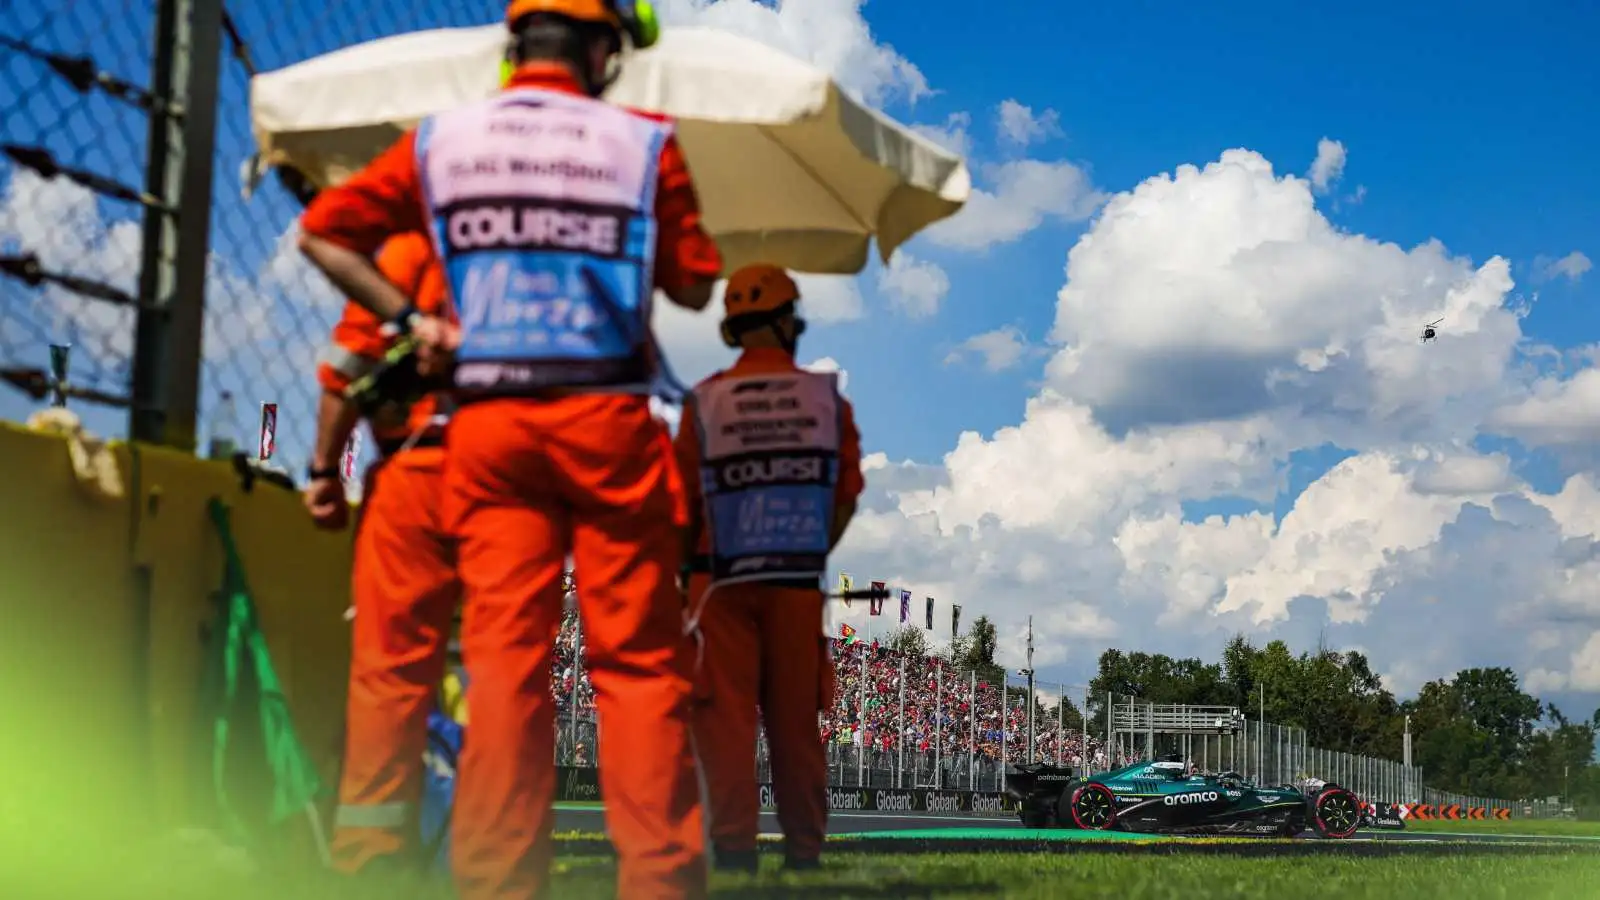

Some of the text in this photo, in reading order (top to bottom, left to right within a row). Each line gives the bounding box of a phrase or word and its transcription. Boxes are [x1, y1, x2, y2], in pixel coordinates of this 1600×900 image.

[450, 206, 618, 253] COURSE
[825, 791, 862, 809] Globant
[876, 791, 912, 810] Globant
[925, 792, 960, 812] Globant
[971, 794, 1003, 812] Globant
[1164, 791, 1218, 806] aramco
